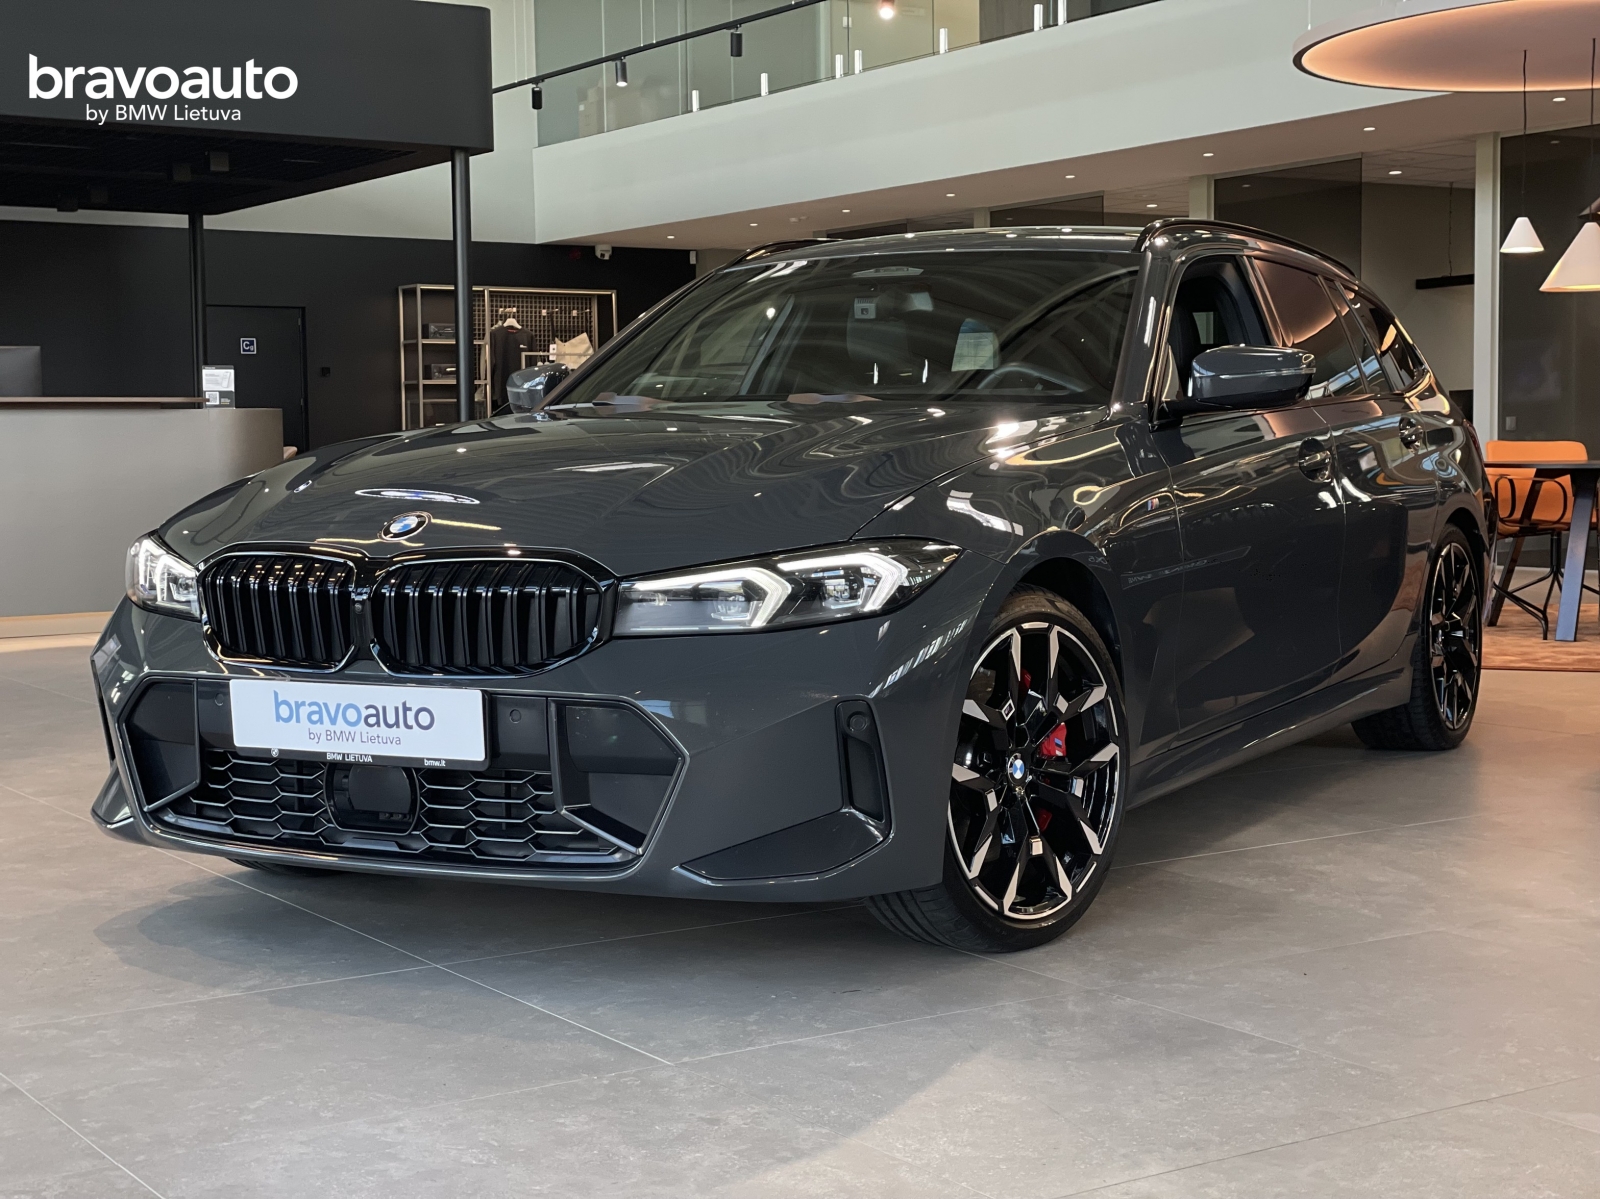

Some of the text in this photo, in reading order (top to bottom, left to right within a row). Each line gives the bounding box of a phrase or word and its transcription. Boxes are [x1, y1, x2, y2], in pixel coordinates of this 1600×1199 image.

[273, 690, 435, 731] bravoauto
[308, 728, 402, 745] by BMW Lietuva
[326, 752, 373, 763] BMW LIETUVA
[424, 758, 446, 767] bmw.lt
